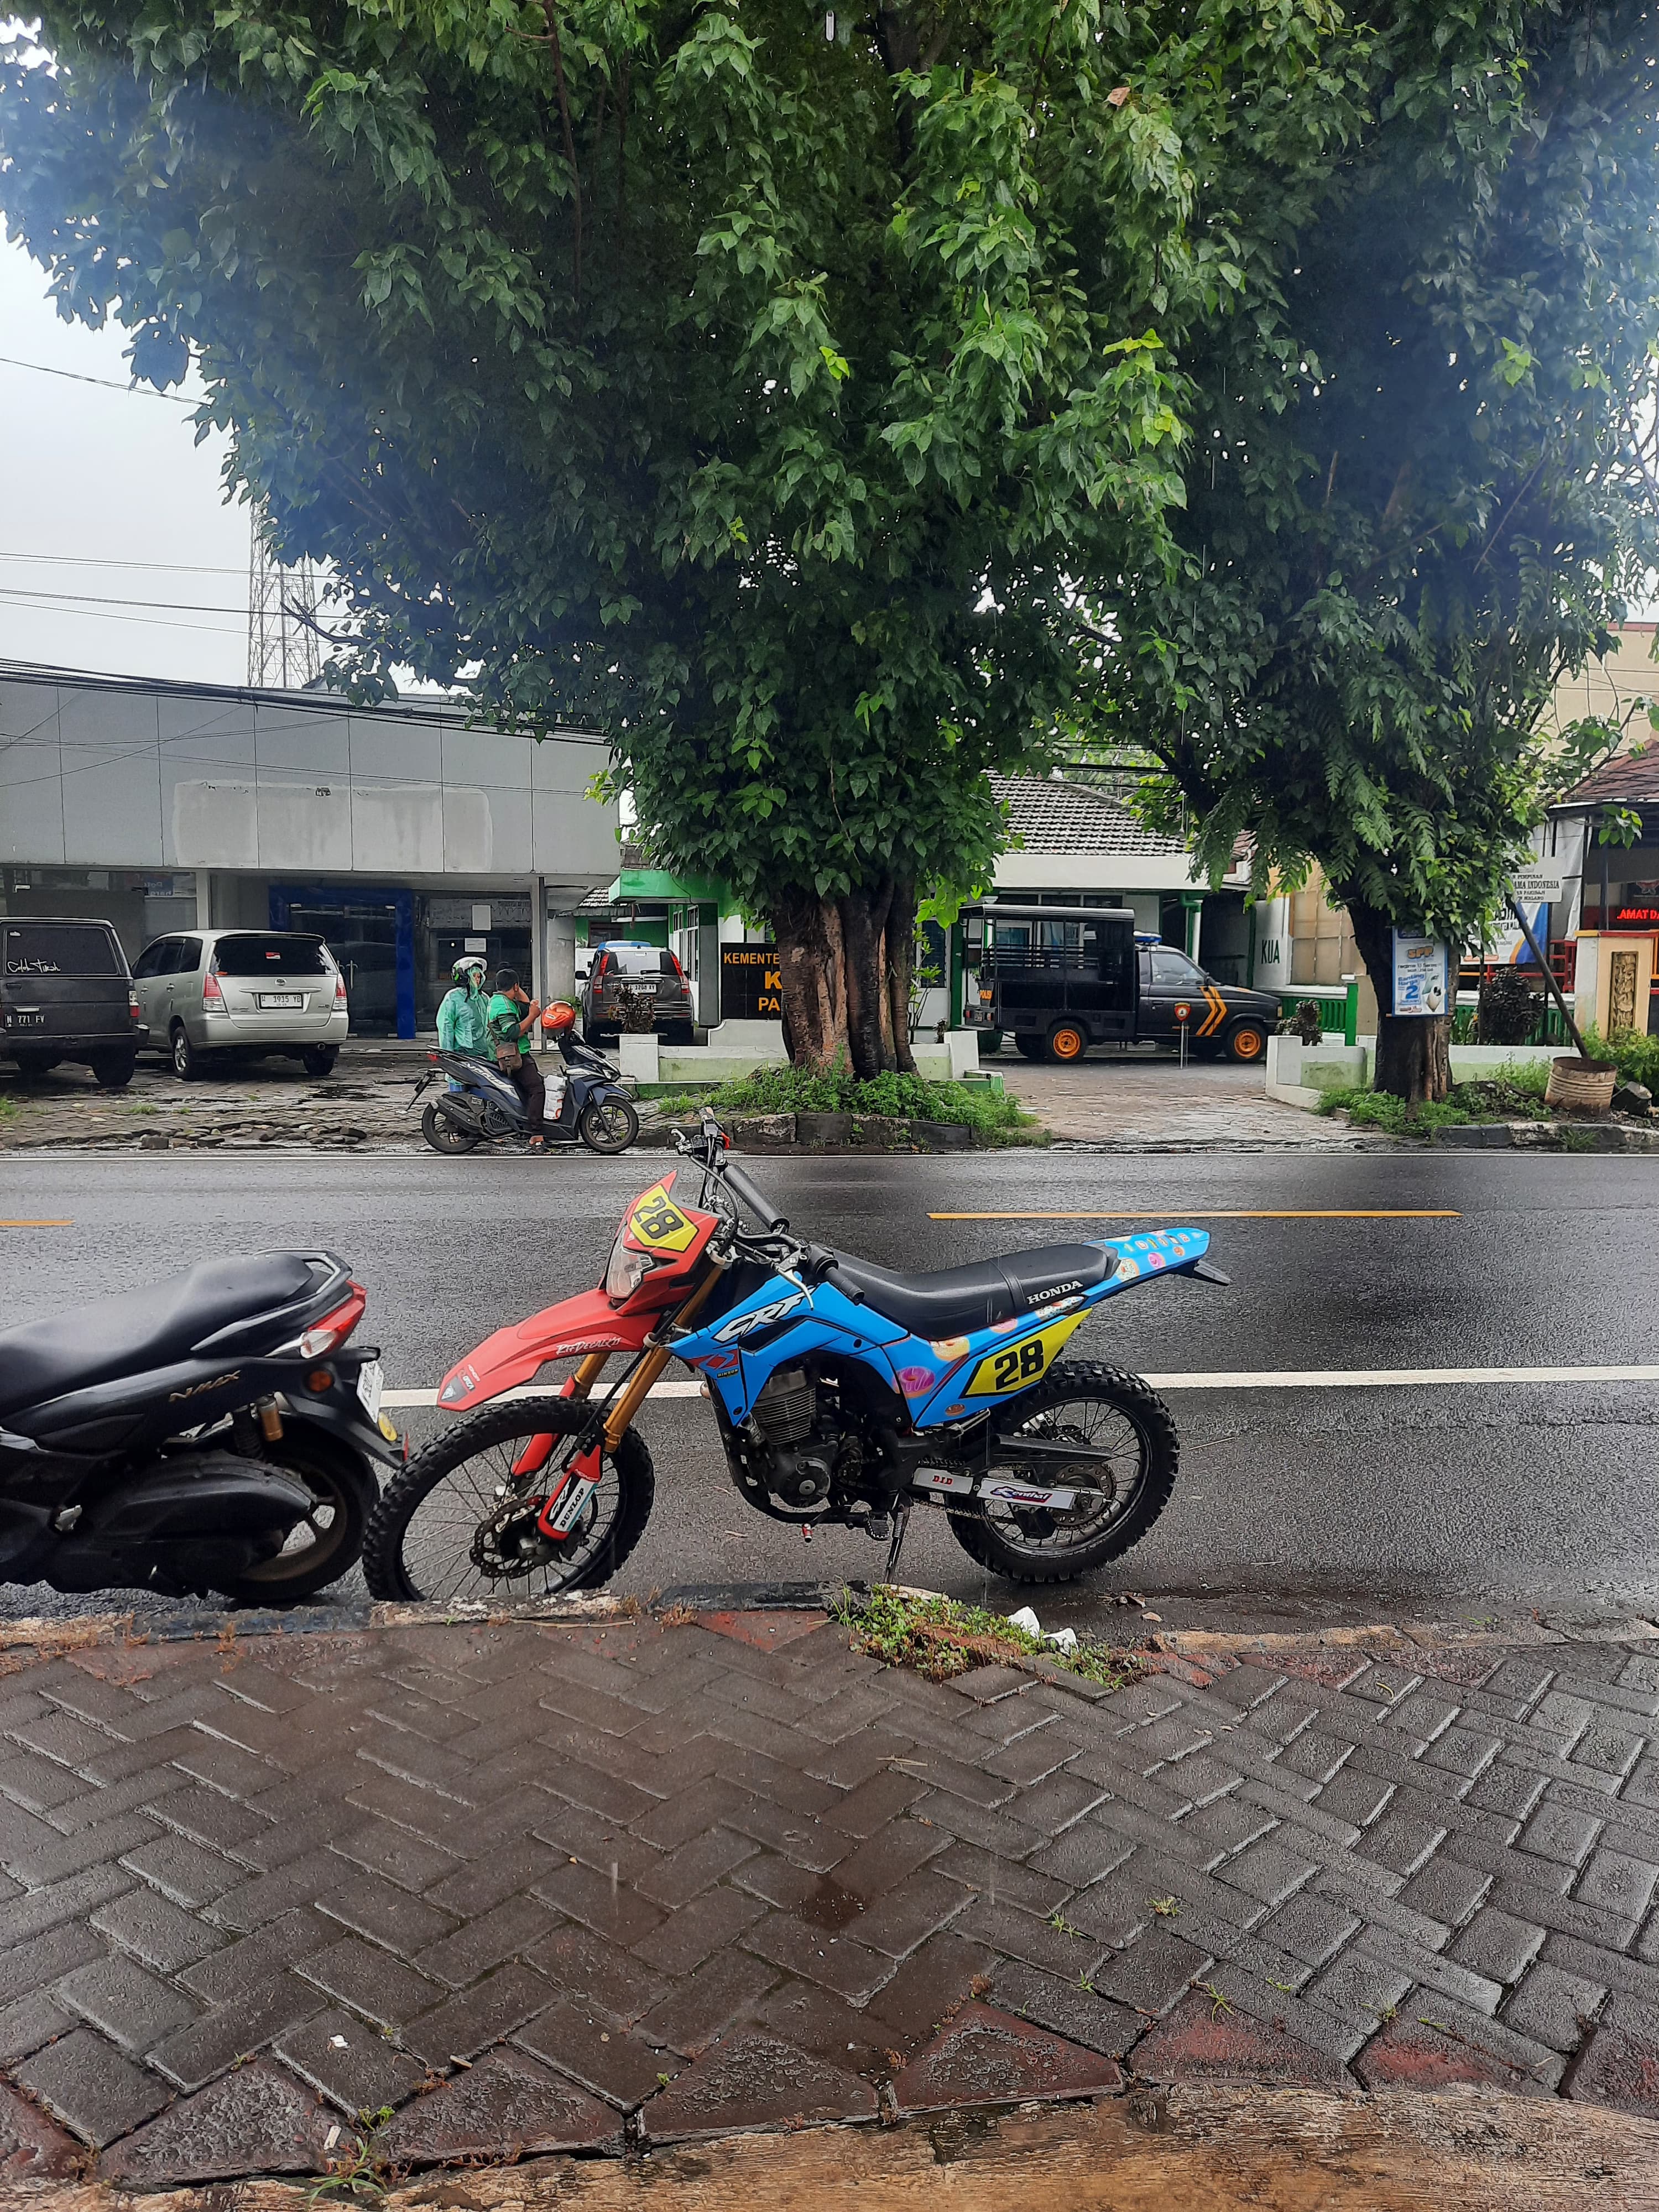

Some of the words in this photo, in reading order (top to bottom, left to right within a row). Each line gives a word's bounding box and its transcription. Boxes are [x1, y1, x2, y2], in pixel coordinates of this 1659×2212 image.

[1528, 880, 1559, 889] INDONESIA
[1617, 909, 1648, 919] AMAT
[723, 952, 780, 964] KEMENTE
[1261, 940, 1280, 964] KUA
[765, 971, 783, 989] K
[1406, 985, 1418, 999] 2
[758, 997, 780, 1011] PA
[7, 1015, 12, 1024] N
[17, 1015, 30, 1024] 771
[634, 1196, 684, 1239] 28
[1026, 1280, 1083, 1305] HONDA
[994, 1339, 1044, 1391] 28
[560, 1487, 585, 1527] DUNLOP
